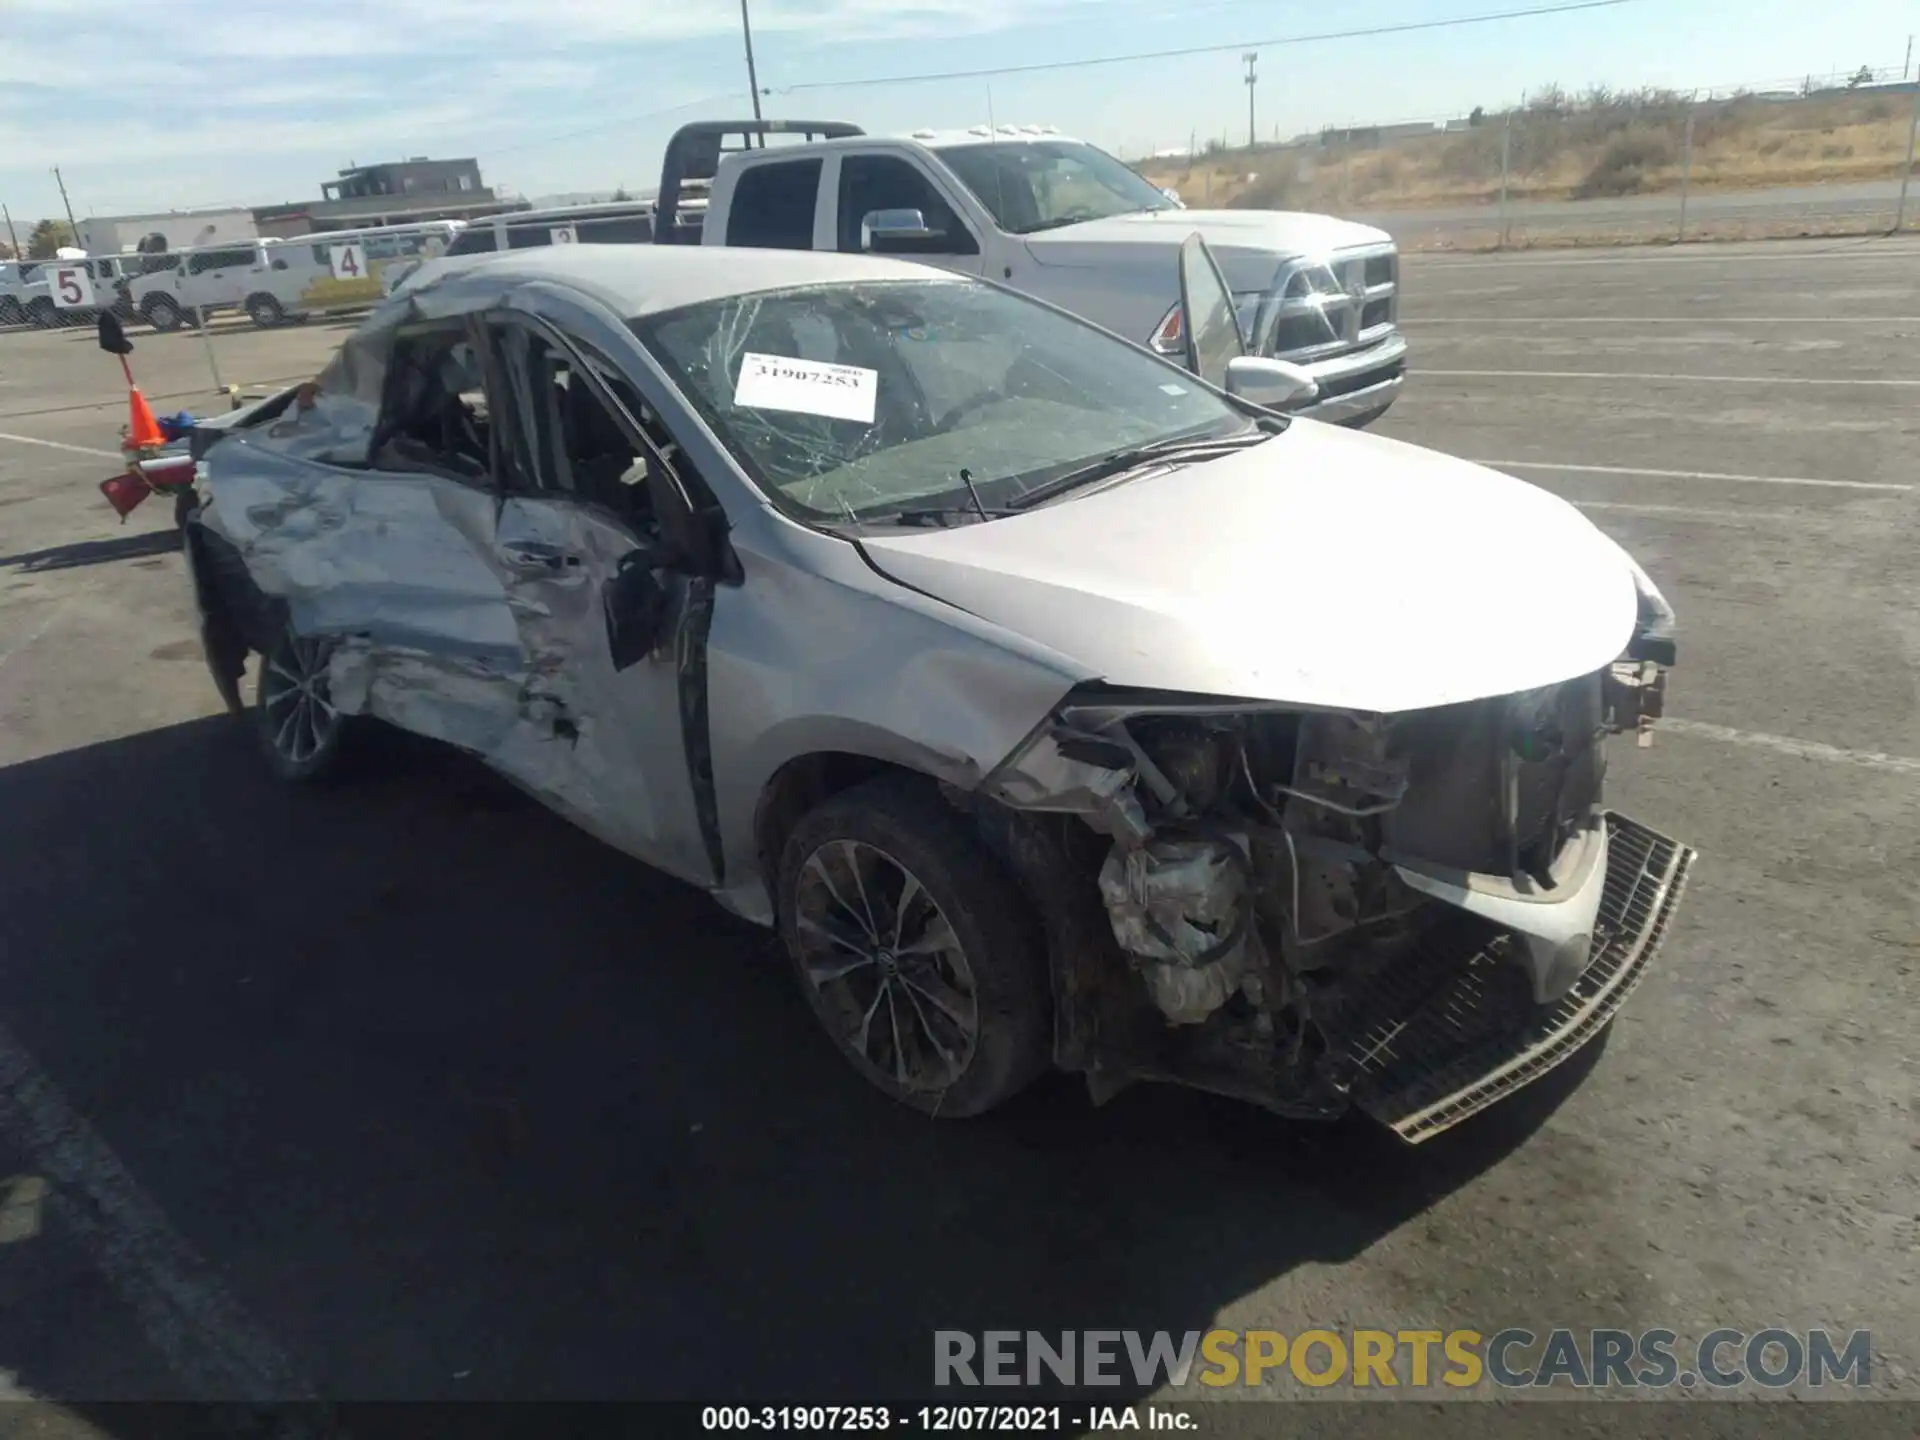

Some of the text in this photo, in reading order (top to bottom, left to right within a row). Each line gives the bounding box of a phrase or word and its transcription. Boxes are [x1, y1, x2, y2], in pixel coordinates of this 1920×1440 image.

[341, 247, 359, 277] 4
[58, 270, 83, 304] 5
[755, 364, 860, 388] 31907253
